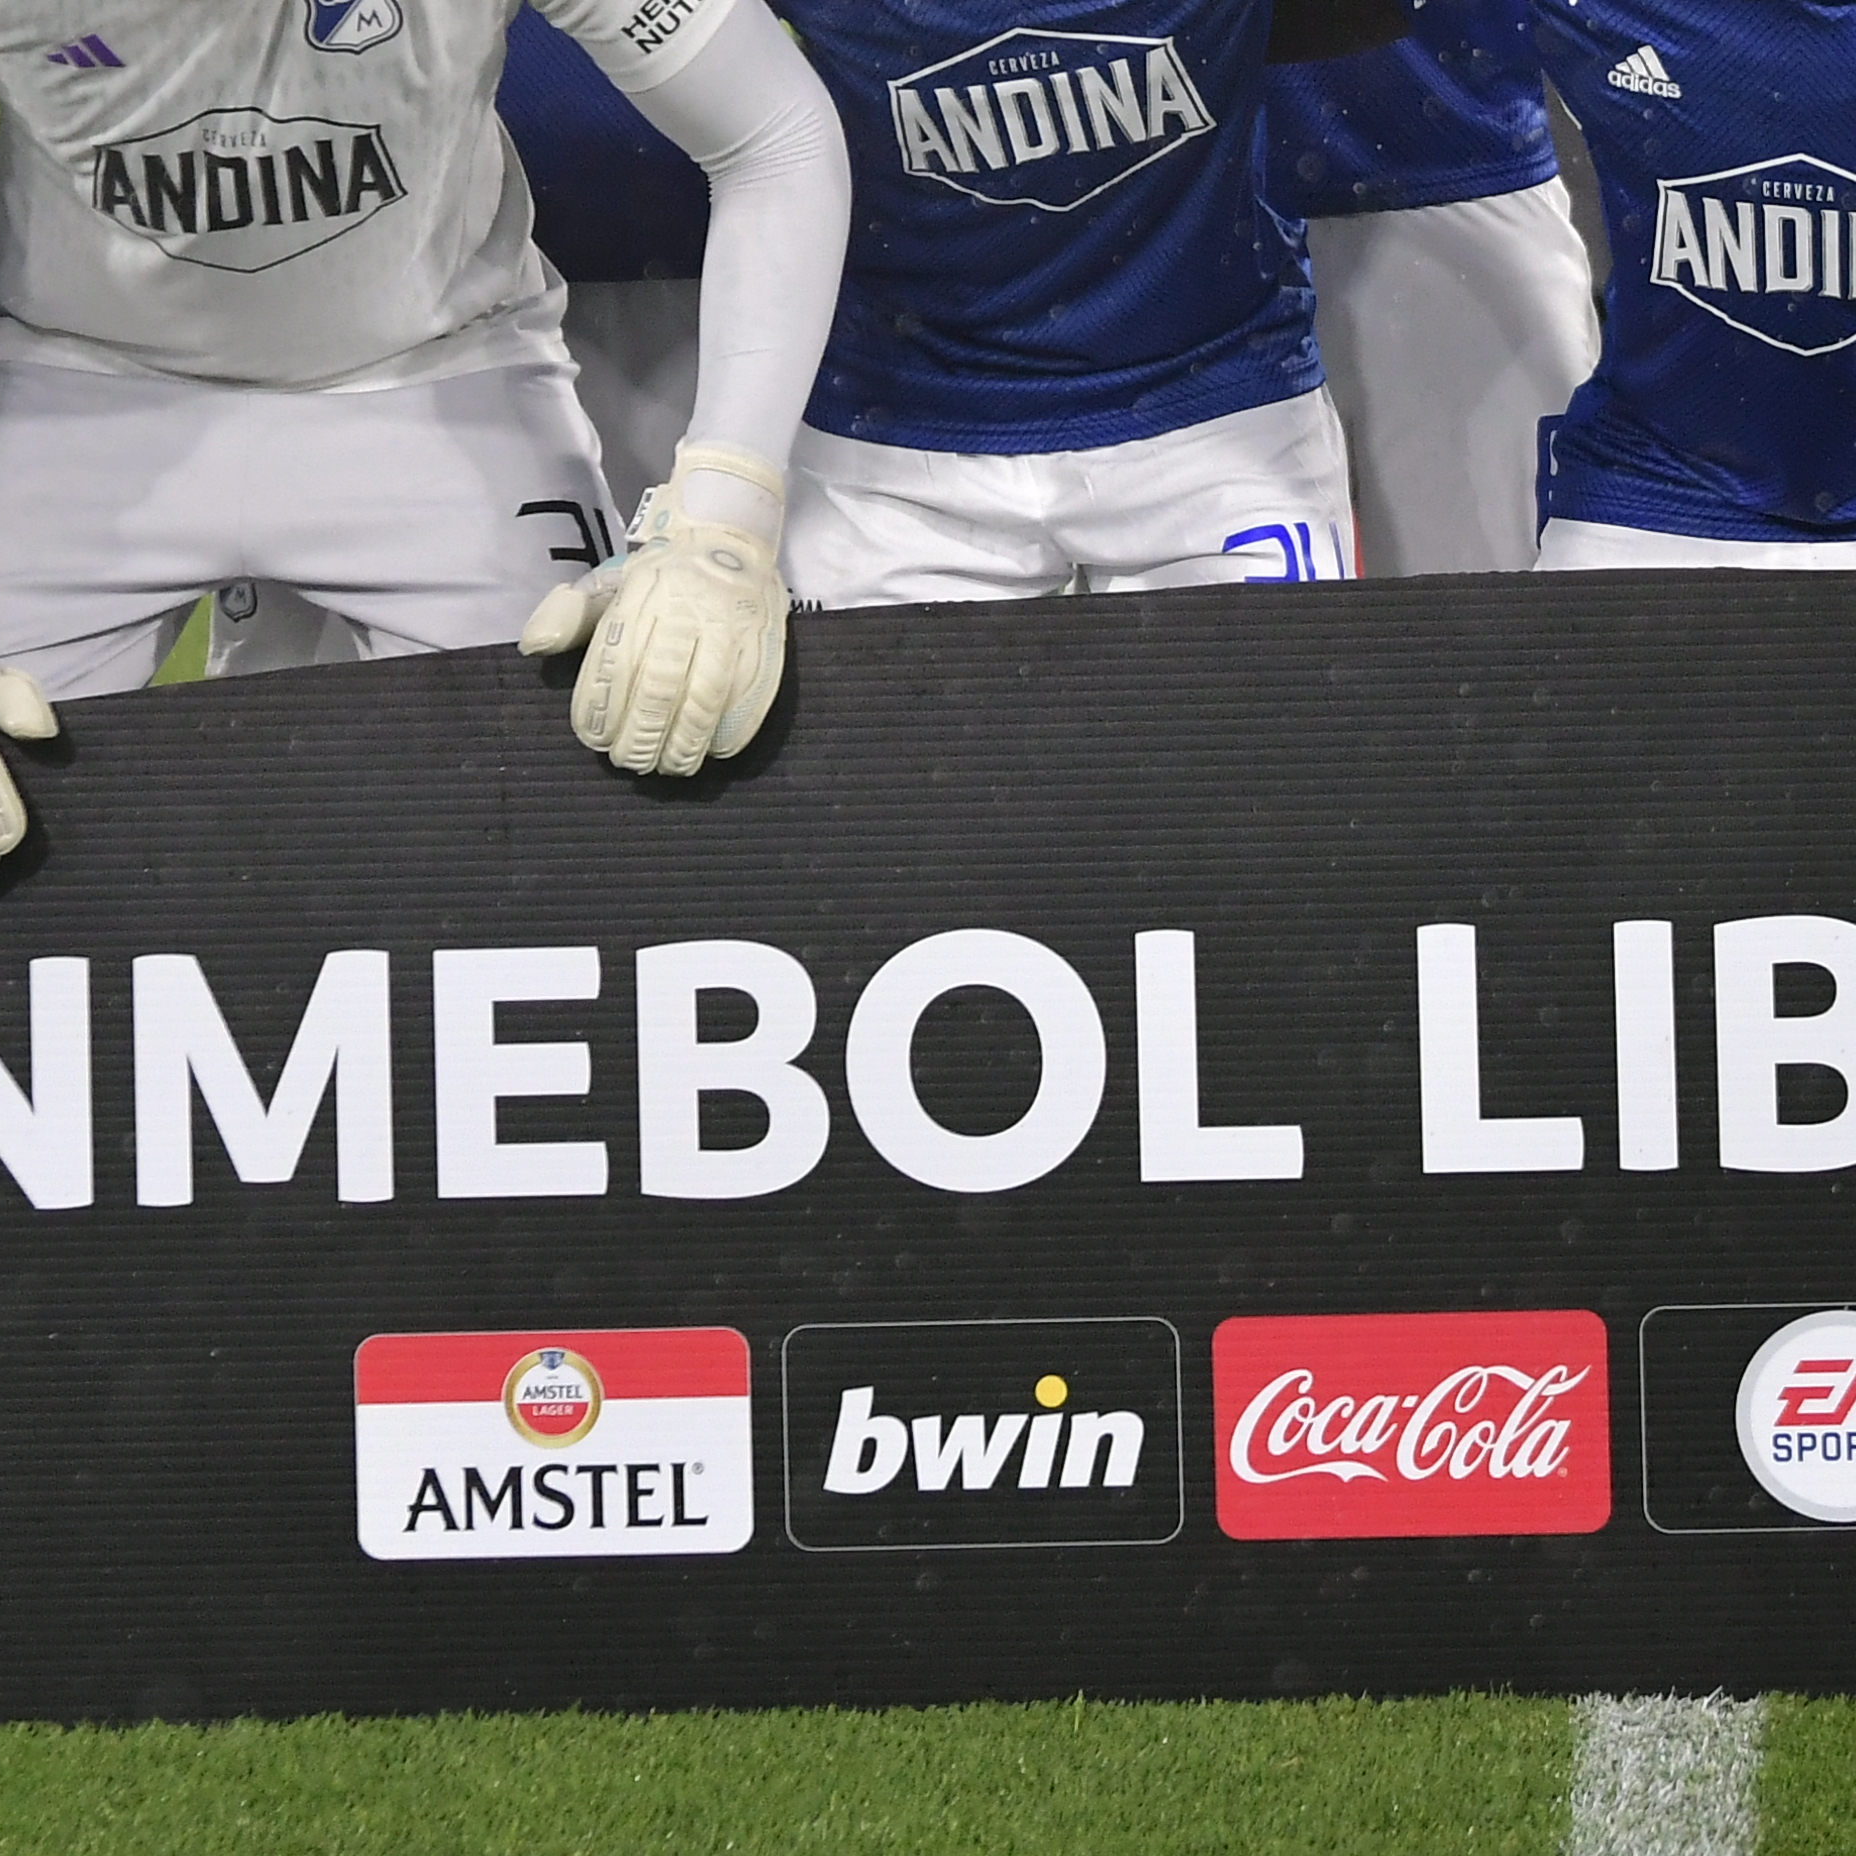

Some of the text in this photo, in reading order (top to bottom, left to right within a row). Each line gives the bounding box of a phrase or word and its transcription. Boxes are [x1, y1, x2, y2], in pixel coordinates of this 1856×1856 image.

[988, 50, 1060, 76] CERVEZA
[1608, 68, 1681, 99] adidas
[896, 44, 1206, 174] ANDINA
[101, 132, 398, 234] ANDINA
[1762, 180, 1835, 203] CERVEZA
[523, 1384, 583, 1400] AMSTEL
[532, 1404, 575, 1417] LAGER
[823, 1374, 1145, 1496] bwin
[1229, 1364, 1593, 1485] Coca-Cola
[402, 1461, 710, 1534] AMSTEL
